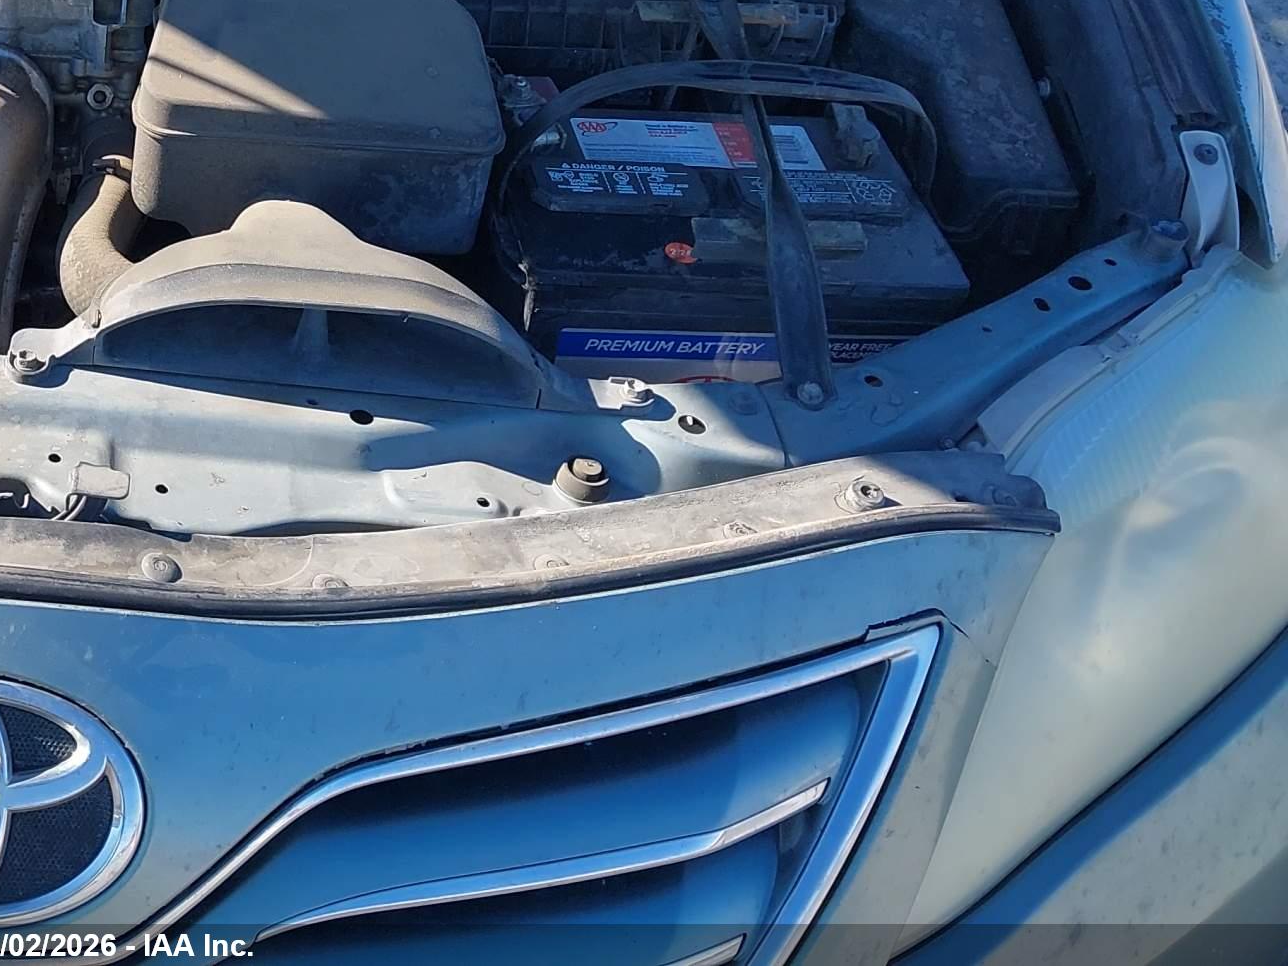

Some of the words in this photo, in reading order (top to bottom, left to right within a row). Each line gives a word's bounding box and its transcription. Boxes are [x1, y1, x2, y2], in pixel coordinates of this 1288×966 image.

[578, 121, 607, 132] AAA
[572, 162, 616, 171] DANGER
[625, 164, 665, 173] POISON
[584, 338, 676, 353] PREMIUM
[676, 341, 766, 355] BATTERY
